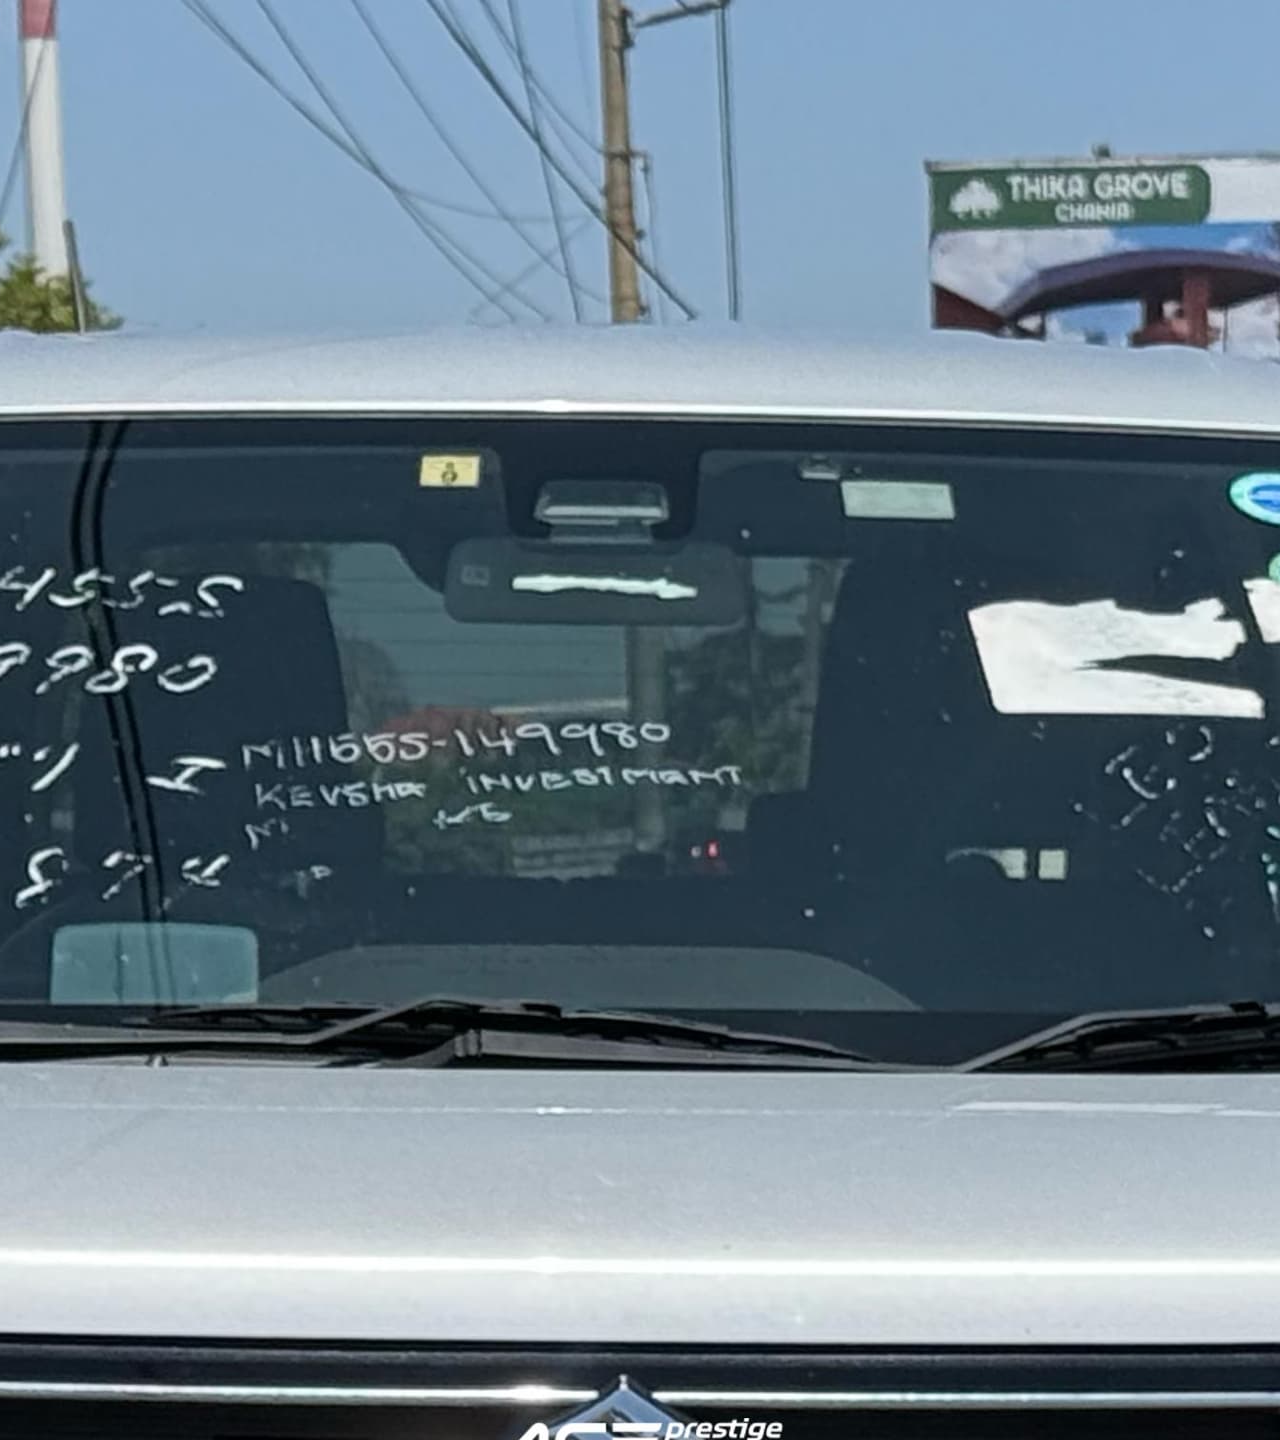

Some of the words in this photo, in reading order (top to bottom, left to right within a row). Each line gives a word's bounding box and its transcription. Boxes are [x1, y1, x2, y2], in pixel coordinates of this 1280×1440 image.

[1006, 174, 1085, 202] THIKA
[1093, 171, 1190, 199] GROVE
[1055, 202, 1134, 222] CHANIA
